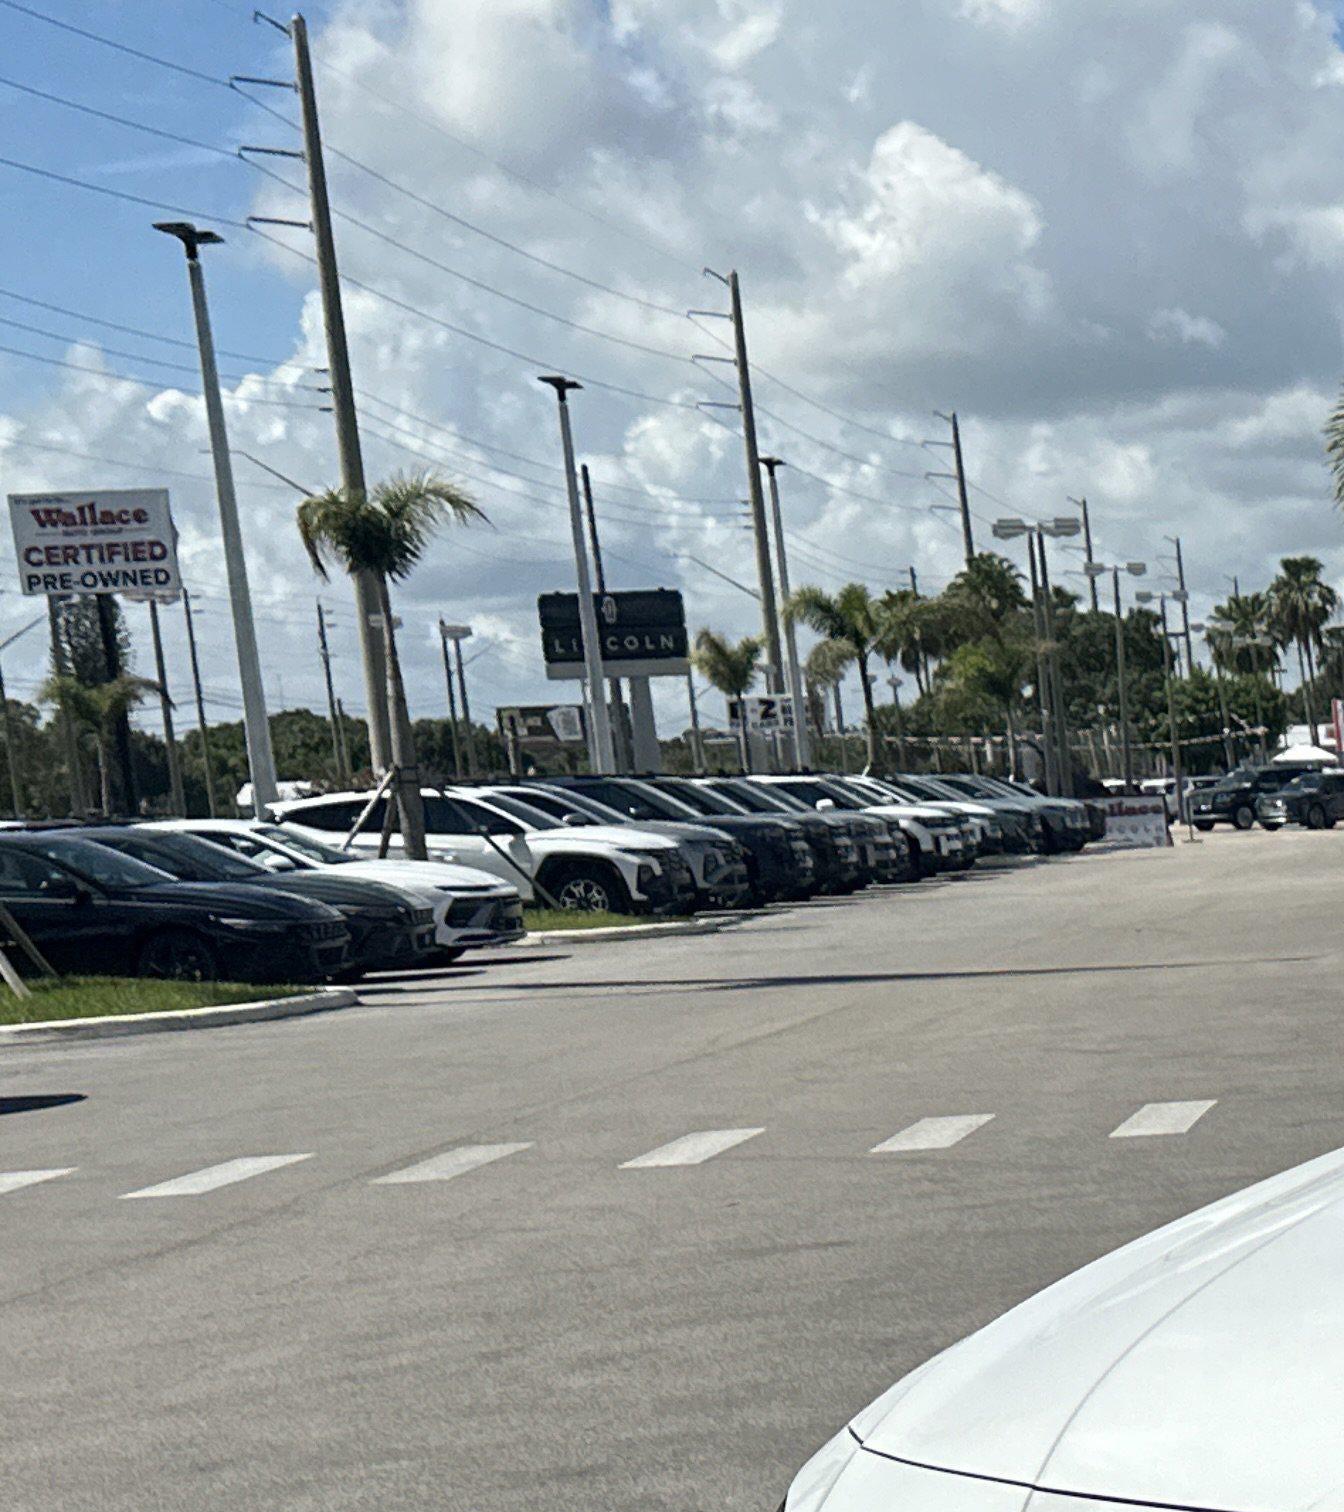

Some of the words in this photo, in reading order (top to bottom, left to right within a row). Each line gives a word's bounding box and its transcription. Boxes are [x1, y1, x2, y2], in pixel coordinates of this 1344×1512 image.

[30, 502, 149, 528] Wallace
[23, 540, 168, 567] CERTIFIED
[27, 567, 170, 591] PRE-OWNED
[554, 634, 674, 653] LICOLN
